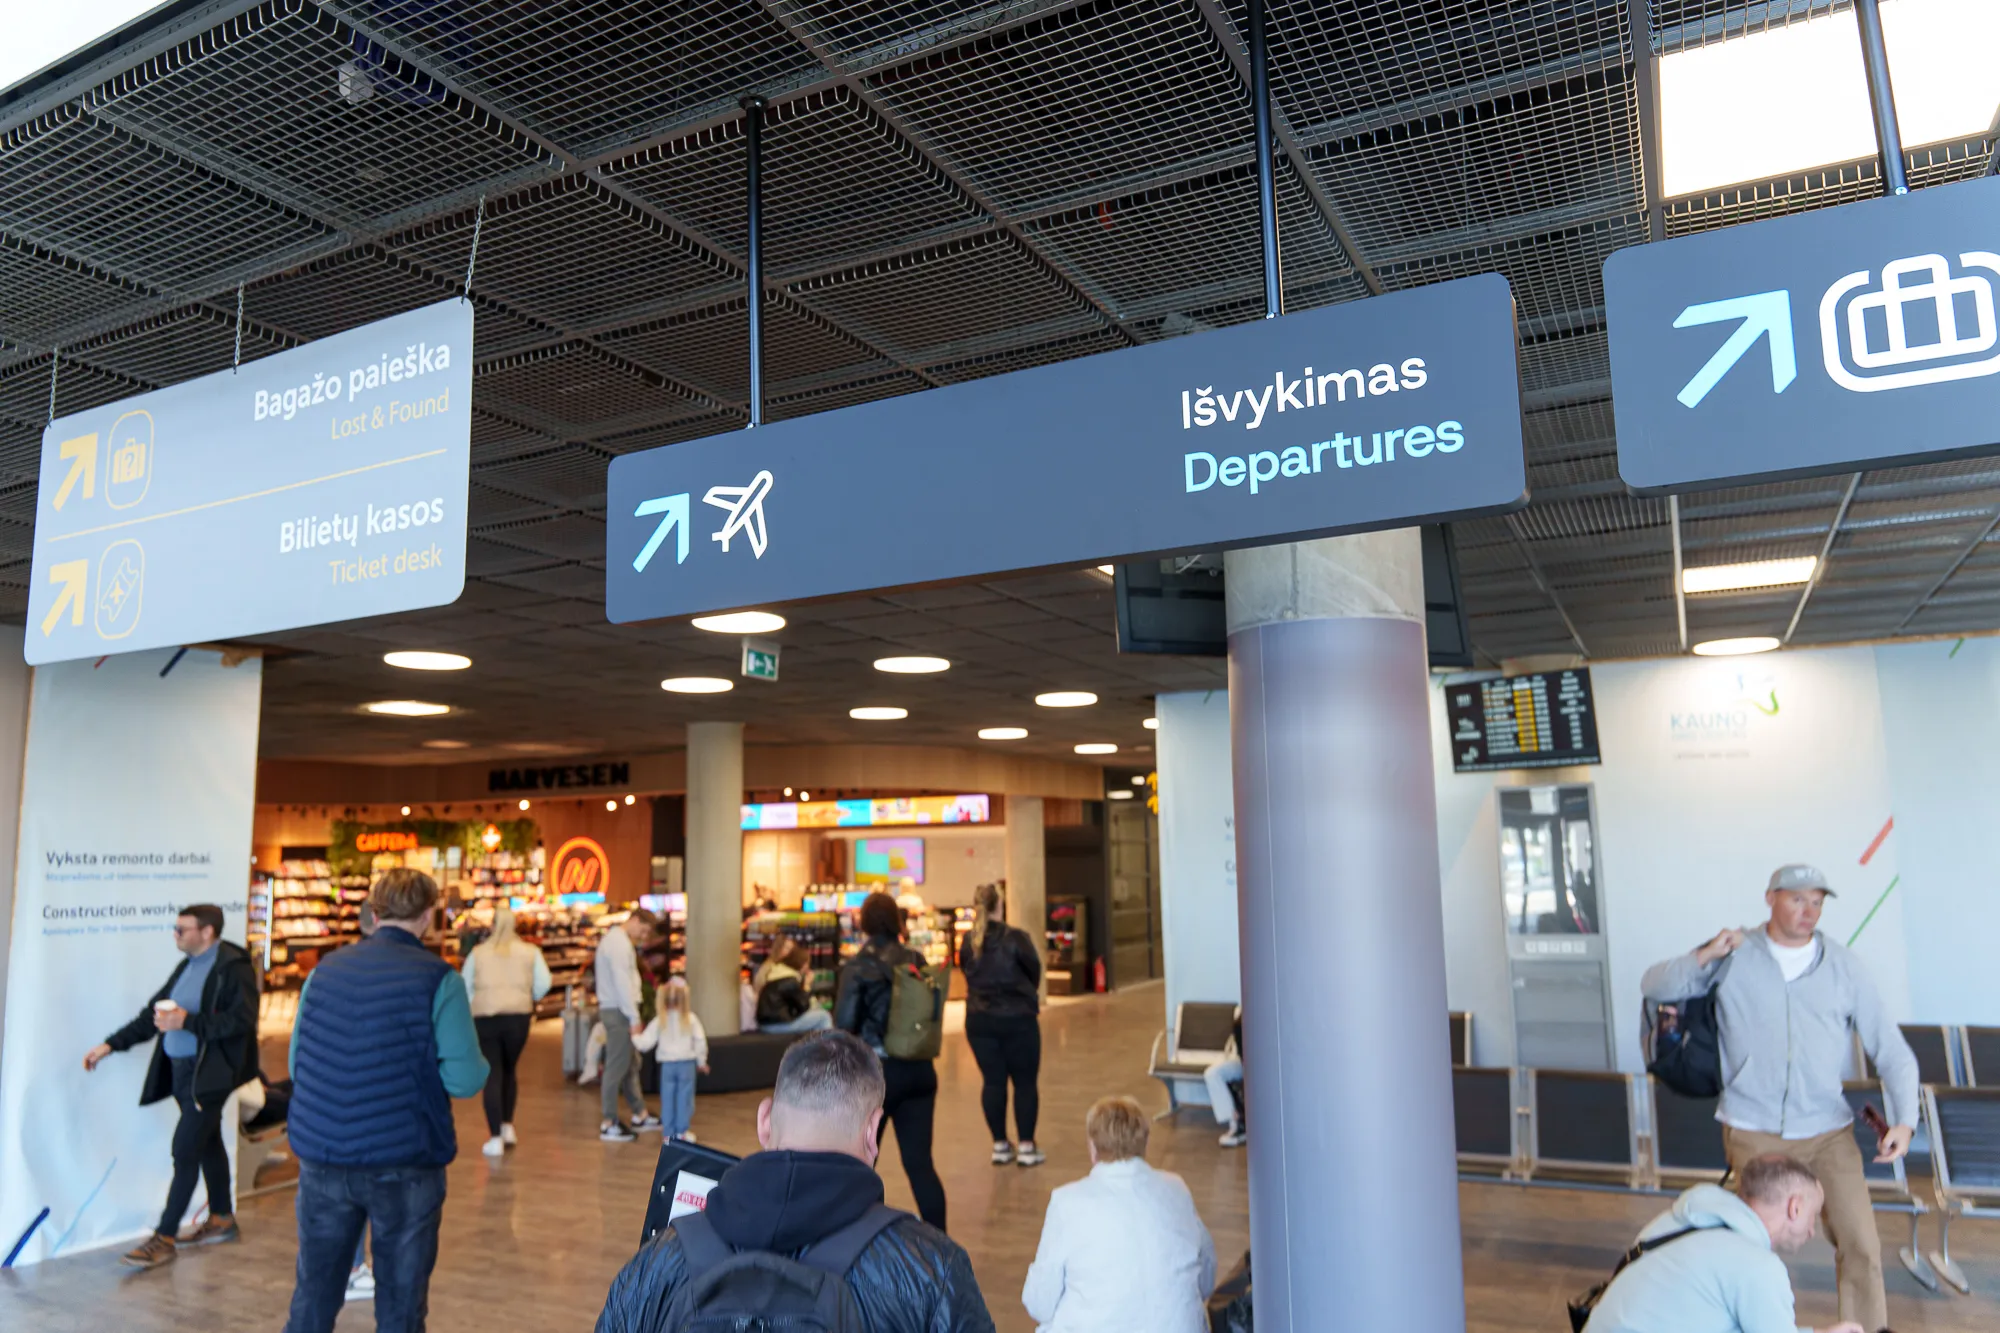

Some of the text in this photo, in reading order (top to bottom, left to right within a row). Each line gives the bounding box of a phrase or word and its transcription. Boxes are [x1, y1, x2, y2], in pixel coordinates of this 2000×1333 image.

[254, 342, 450, 422] Bagažo paieška
[1181, 356, 1428, 430] Išvykimas
[331, 387, 450, 440] Lost & Found
[1184, 419, 1465, 495] Departures
[279, 497, 444, 554] Bilietų kasos
[329, 541, 443, 586] Ticket desk
[1669, 711, 1748, 730] KAUNO
[46, 851, 97, 868] Vyksta
[102, 852, 164, 866] remonto
[43, 902, 136, 920] Construction
